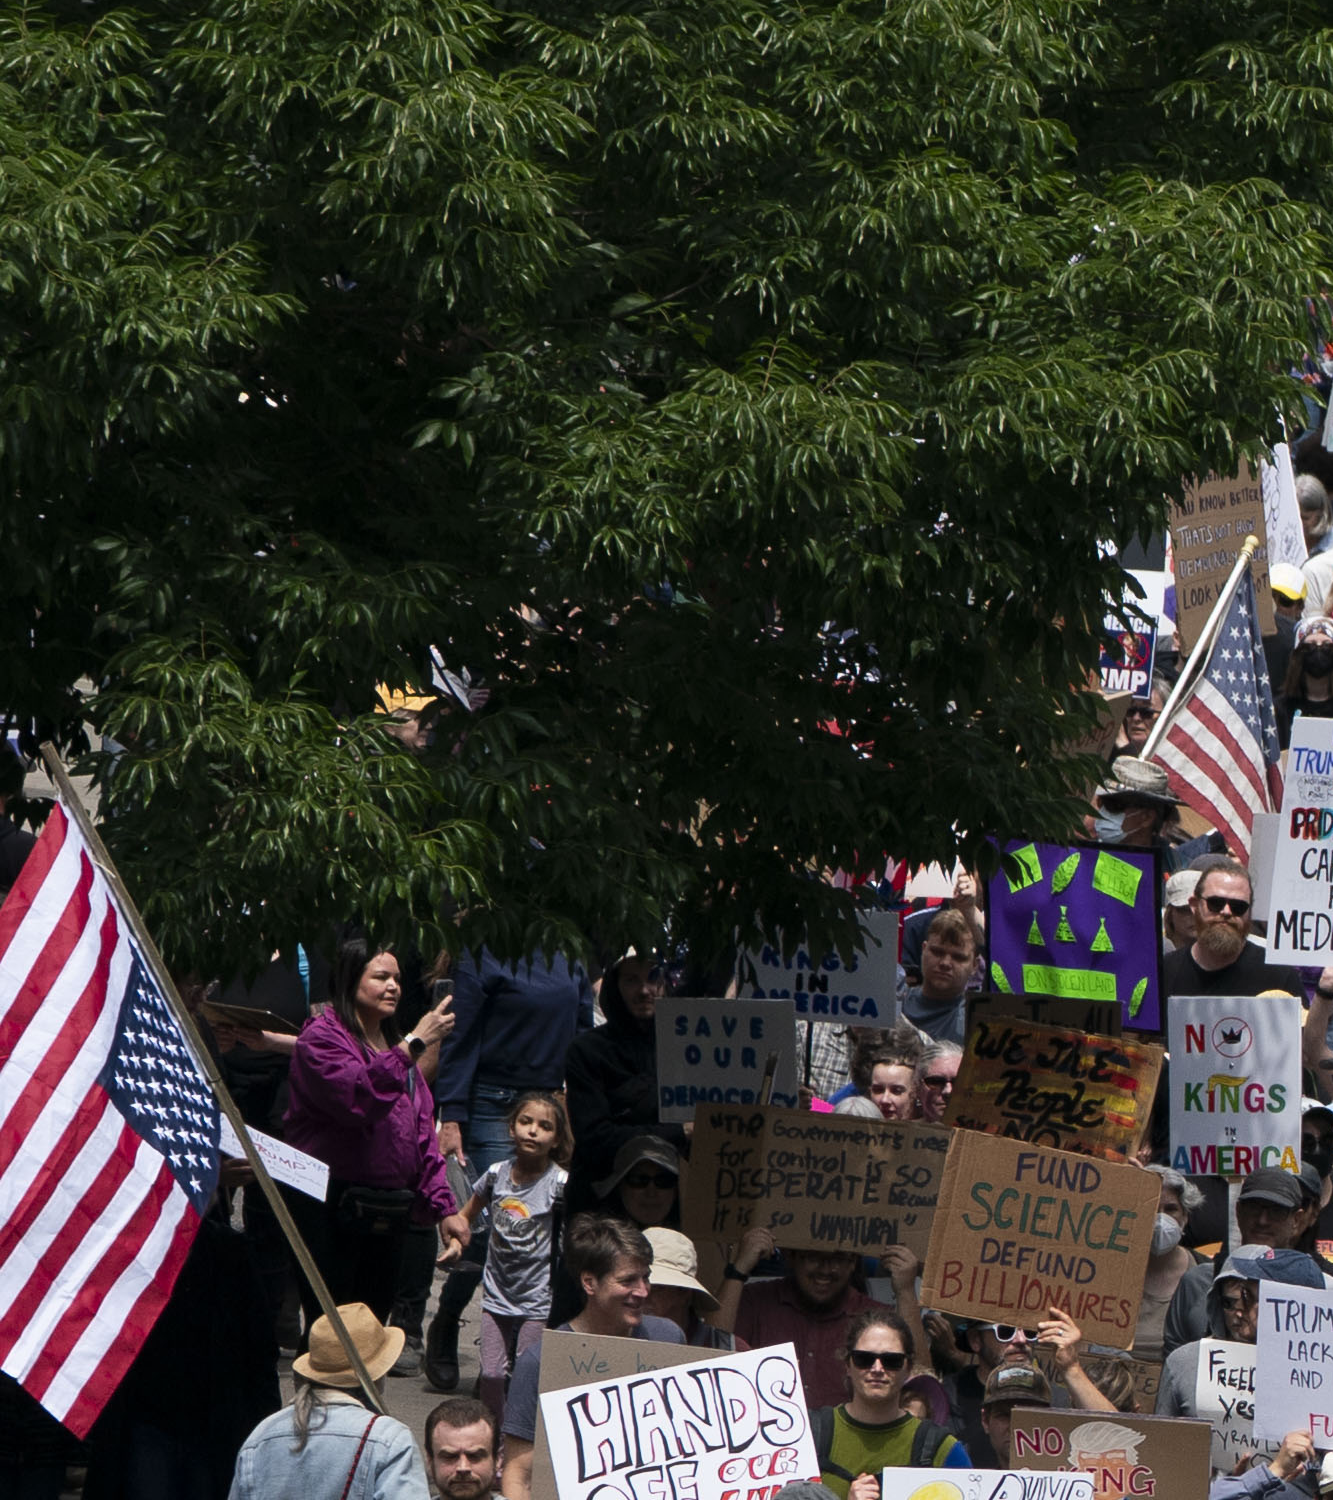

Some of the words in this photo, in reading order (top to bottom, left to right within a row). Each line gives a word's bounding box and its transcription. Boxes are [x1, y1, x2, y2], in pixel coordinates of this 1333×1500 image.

[1016, 1154, 1102, 1192] FUND
[963, 1183, 1137, 1252] SCIENCE
[980, 1238, 1095, 1284] DEFUND
[941, 1262, 1132, 1327] BILLIONAIRES
[1290, 1368, 1328, 1390] AND
